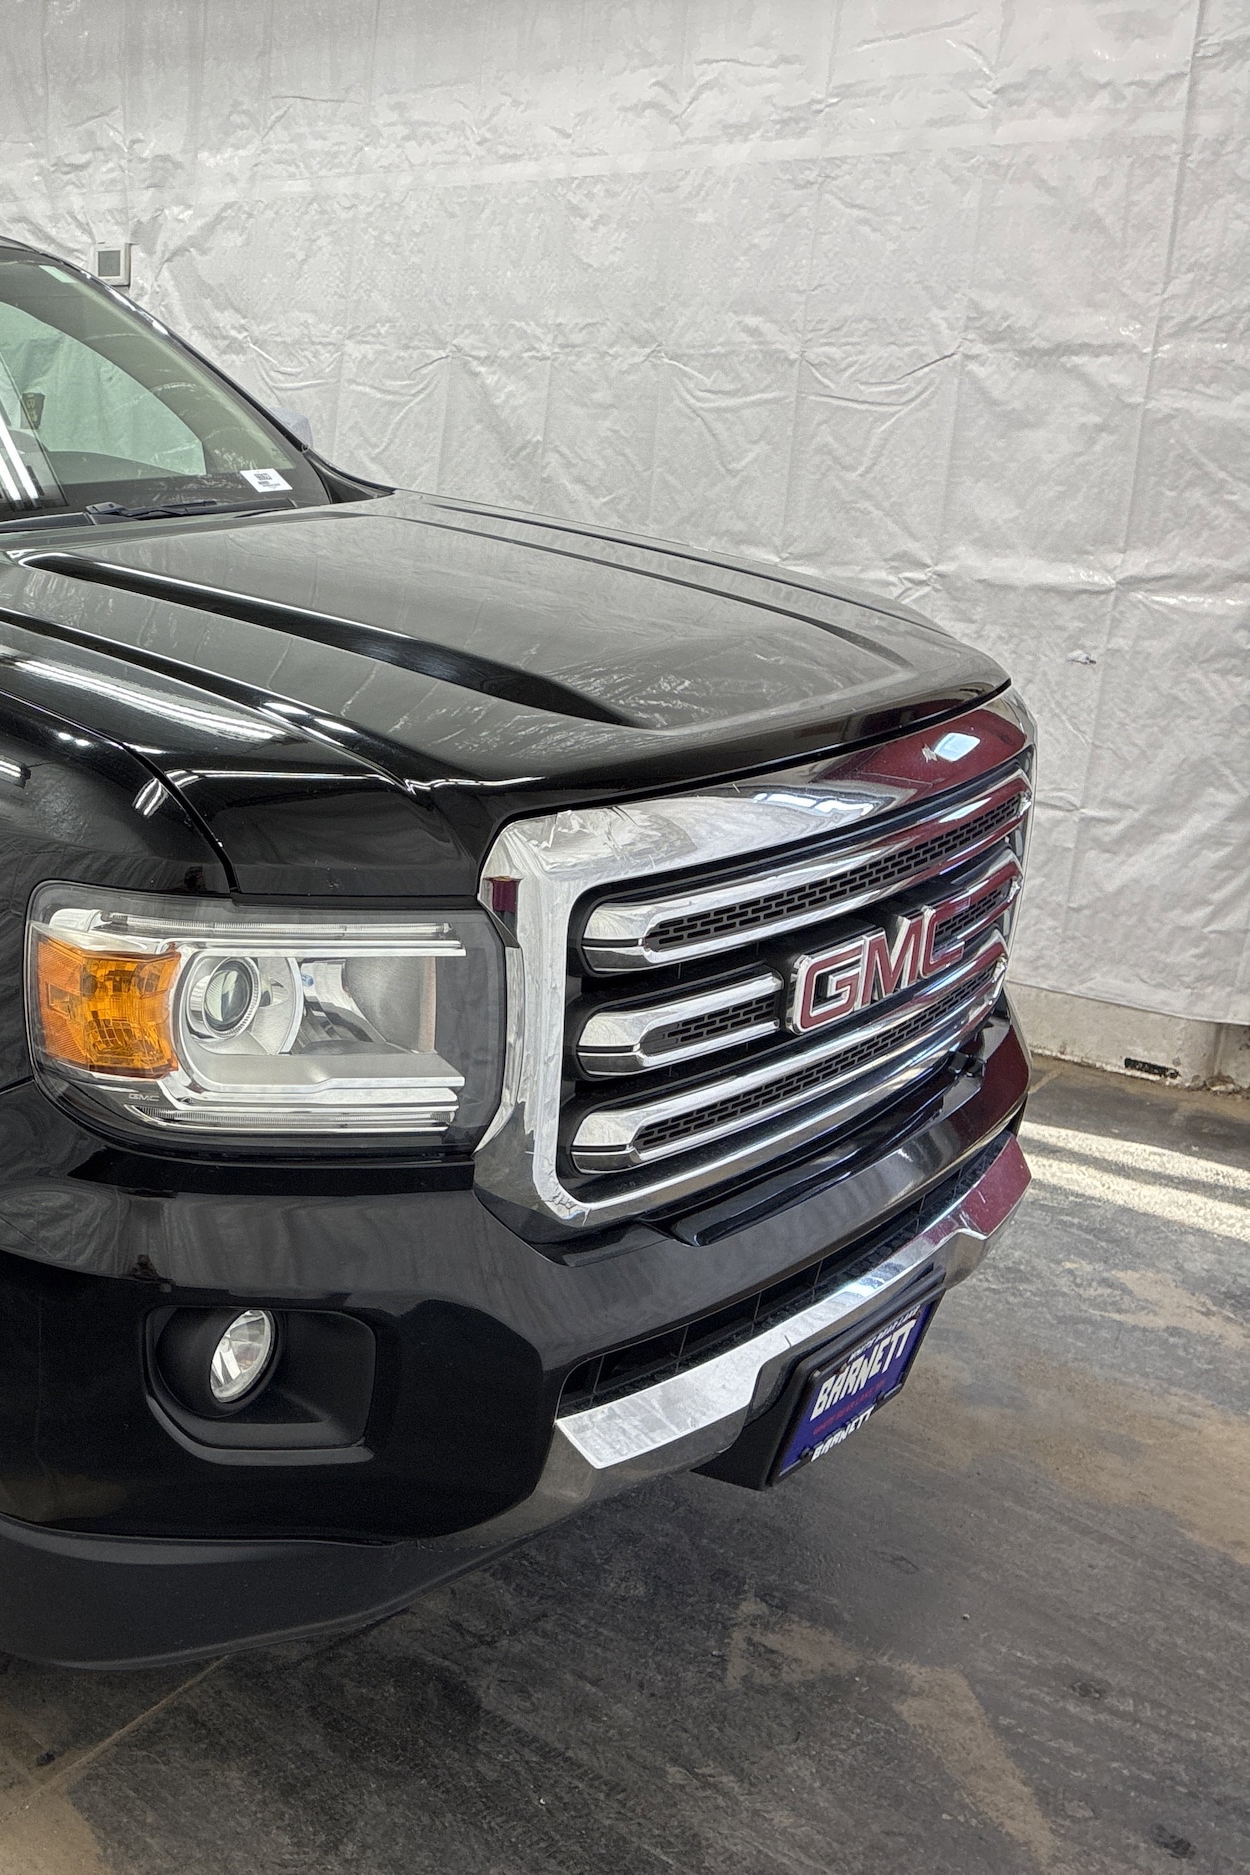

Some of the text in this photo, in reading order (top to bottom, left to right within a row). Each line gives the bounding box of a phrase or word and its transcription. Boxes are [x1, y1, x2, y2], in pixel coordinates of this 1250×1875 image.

[788, 898, 971, 1035] GMC
[128, 1093, 159, 1102] GMC
[810, 1318, 917, 1422] BARNETT
[811, 1404, 875, 1462] BARNETT
